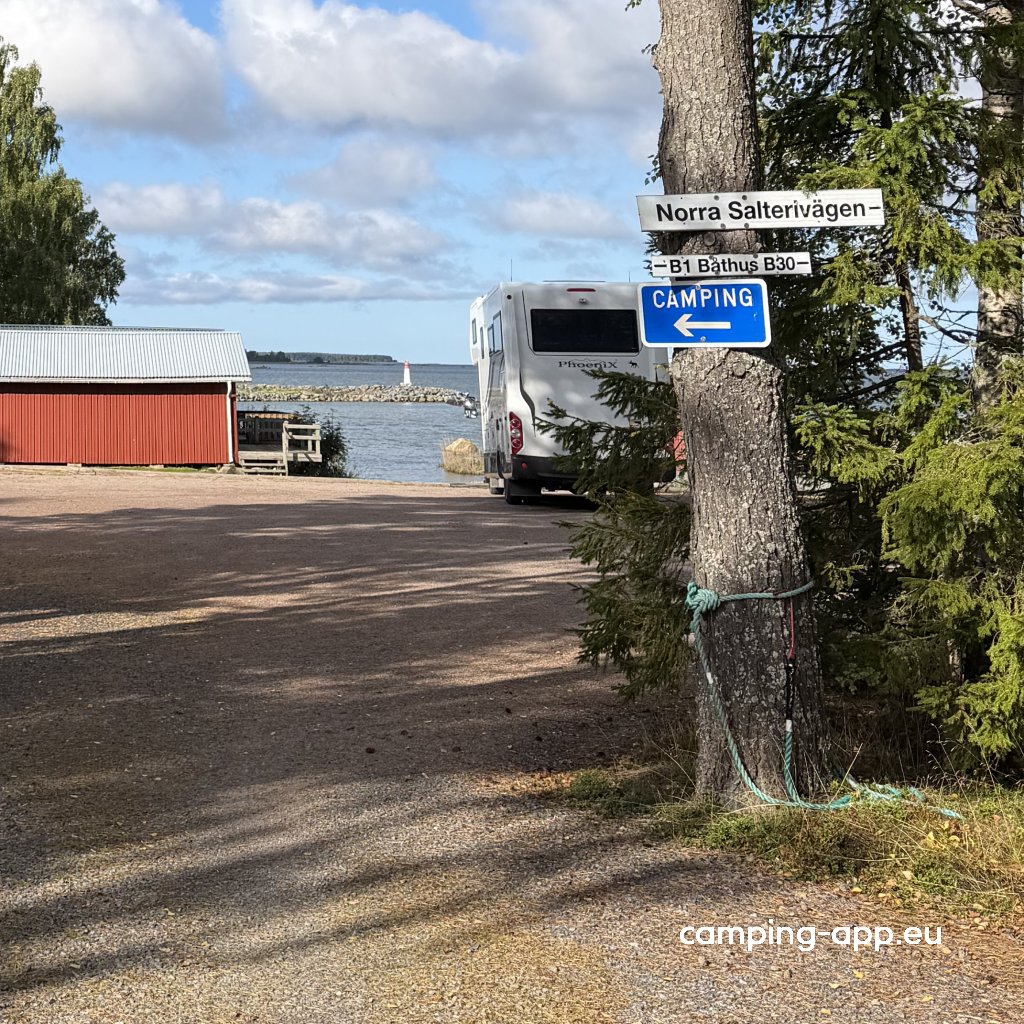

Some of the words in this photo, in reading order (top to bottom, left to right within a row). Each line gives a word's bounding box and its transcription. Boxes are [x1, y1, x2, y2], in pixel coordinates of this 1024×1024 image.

[656, 202, 721, 222] Norra
[728, 198, 866, 224] Salterivägen
[698, 257, 758, 273] Båthus
[652, 288, 753, 309] CAMPING
